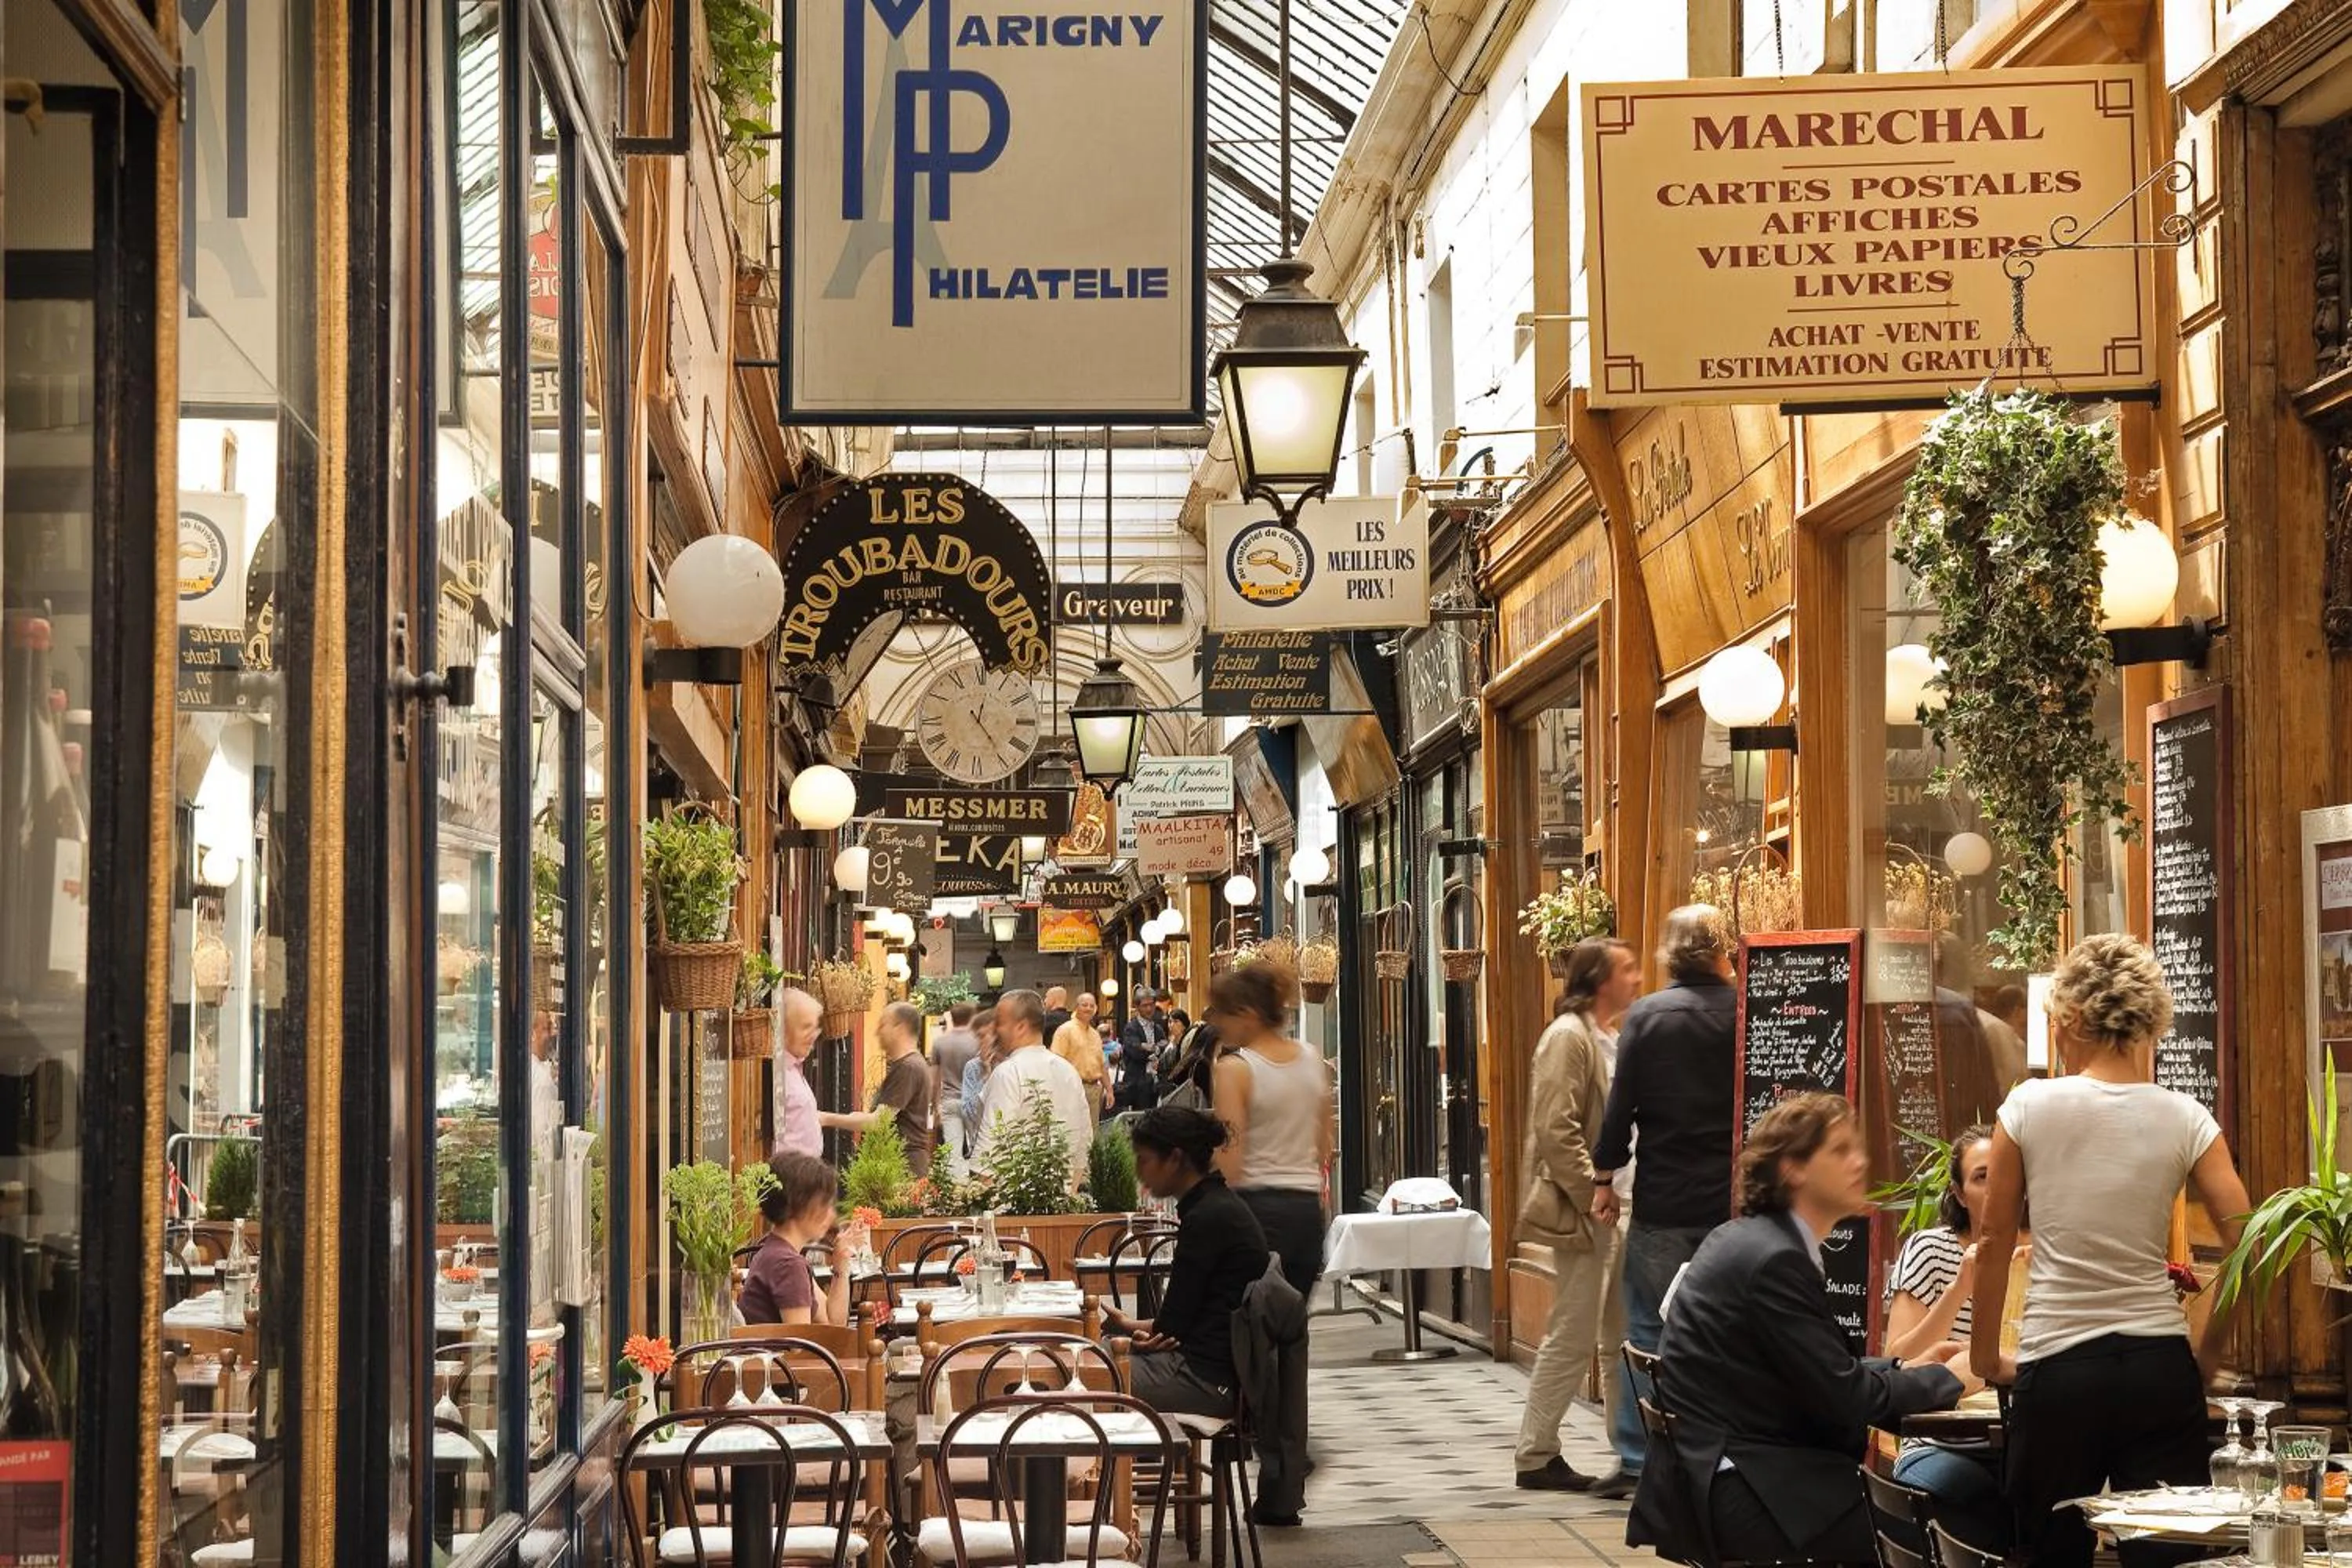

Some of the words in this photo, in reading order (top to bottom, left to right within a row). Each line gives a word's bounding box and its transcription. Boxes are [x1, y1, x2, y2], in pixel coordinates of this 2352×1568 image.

[1692, 106, 2045, 151] MARECHAL
[1656, 180, 1832, 207] CARTES
[1852, 170, 2082, 201] POSTALES
[1761, 206, 1980, 235] AFFICHES
[1697, 243, 1840, 269] VIEUX
[1855, 235, 2044, 264] PAPIERS
[1794, 270, 1955, 298] LIVRES
[1768, 324, 1866, 348] ACHAT
[1699, 353, 1889, 380] ESTIMATION
[1901, 347, 2053, 374] GRATUITE
[869, 488, 965, 524] LES
[1356, 521, 1385, 543] LES
[1265, 528, 1277, 537] de
[1279, 532, 1304, 578] collections
[1327, 548, 1415, 573] MEILLEURS
[902, 570, 921, 584] BAR
[884, 586, 944, 601] RESTAURANT
[1347, 579, 1385, 600] PRIX
[779, 534, 1050, 670] TROUBADOURS
[1063, 590, 1174, 618] Graveur
[1212, 653, 1261, 671] Achat
[1279, 653, 1320, 670] Vente
[1208, 673, 1307, 690] Estimation
[1250, 692, 1326, 709] Gratuite
[905, 797, 1048, 820] MESSMER
[1138, 818, 1221, 835] MAALKITA
[1156, 834, 1207, 846] artisanat
[1208, 847, 1225, 857] 49
[1147, 860, 1177, 872] mode
[20, 1554, 60, 1566] LEBEY
